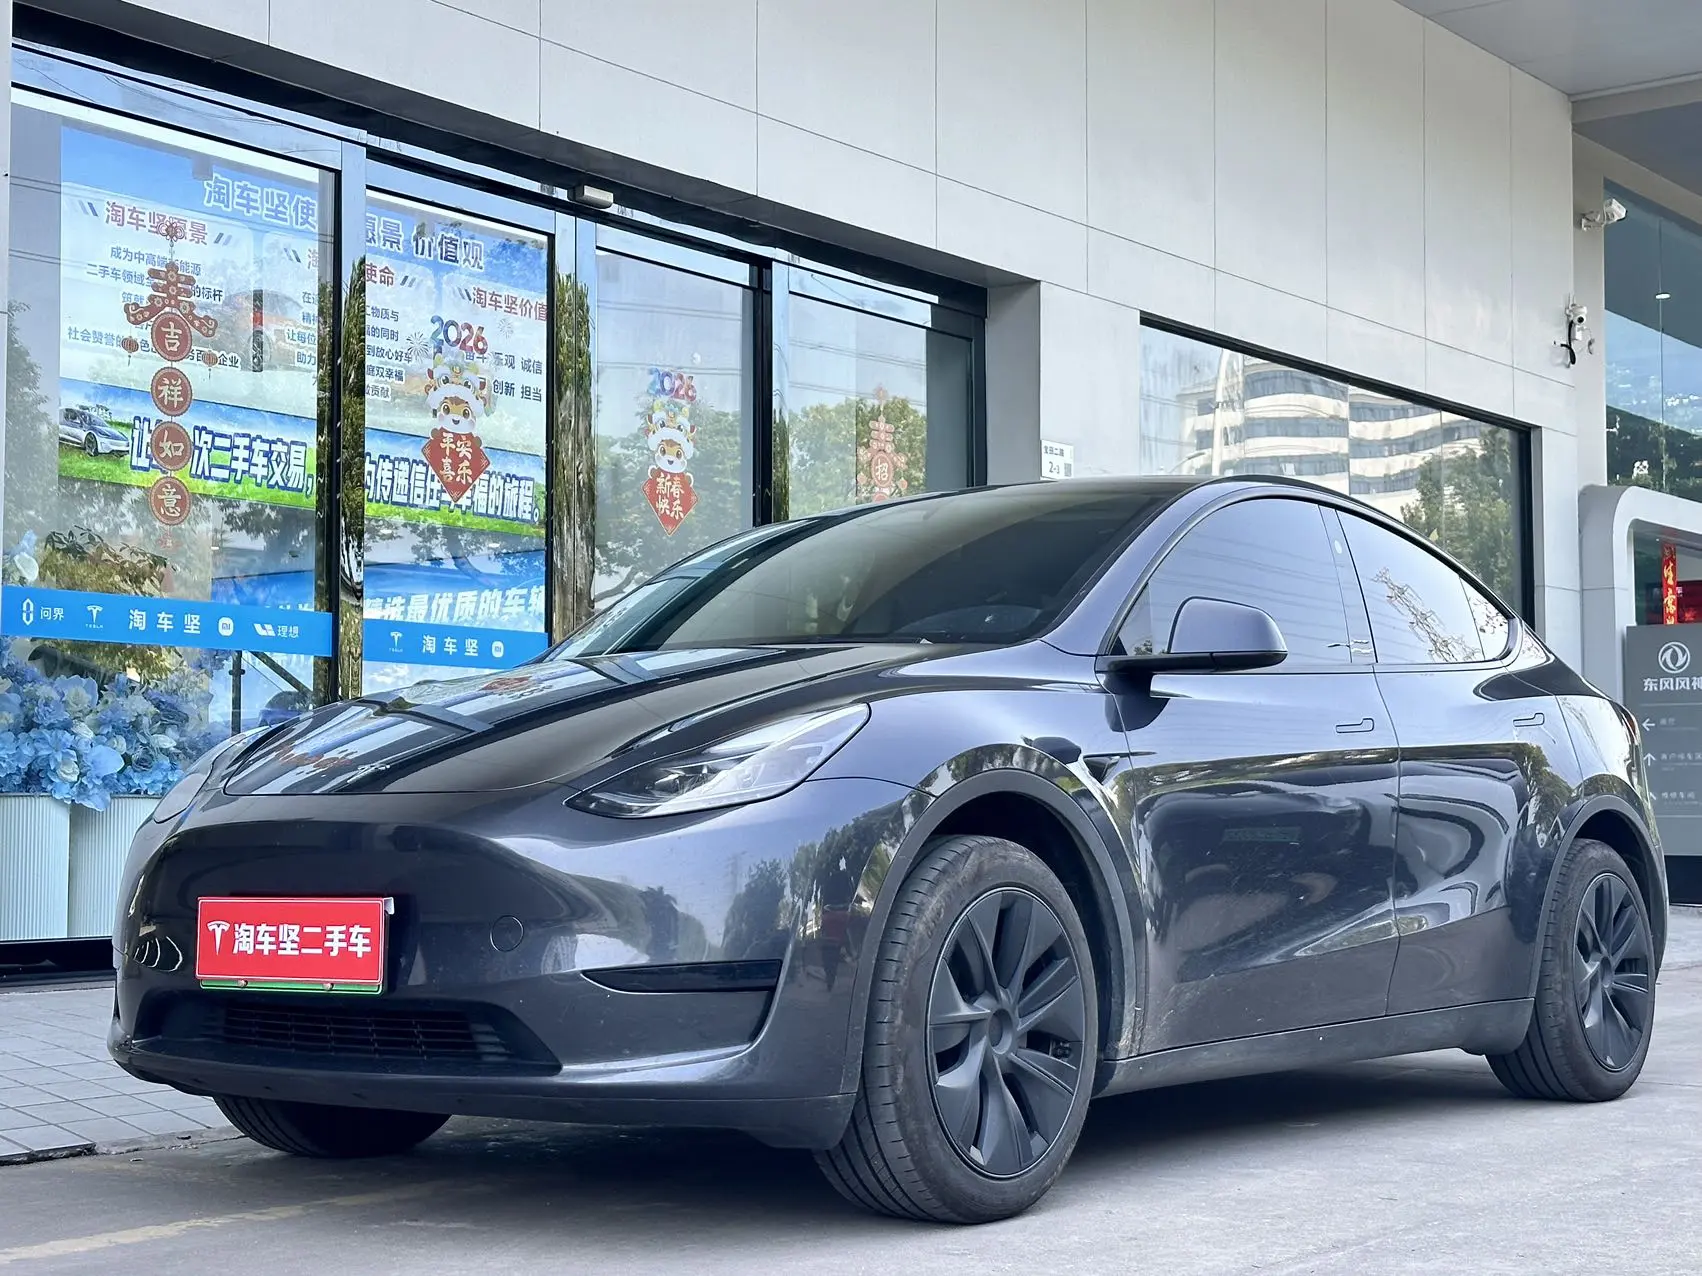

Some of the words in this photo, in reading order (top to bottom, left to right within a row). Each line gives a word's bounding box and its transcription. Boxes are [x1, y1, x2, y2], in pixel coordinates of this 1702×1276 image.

[430, 315, 488, 355] 2026
[521, 357, 543, 374] 诚信
[493, 380, 515, 397] 创新
[521, 384, 542, 402] 担当
[648, 367, 697, 402] 2026
[656, 472, 684, 498] 新春
[655, 494, 684, 520] 快乐
[40, 607, 64, 621] 问界
[129, 609, 201, 634] 淘车坚
[277, 625, 299, 638] 理想
[422, 635, 478, 657] 淘车坚
[233, 923, 372, 958] 淘车坚二手车
